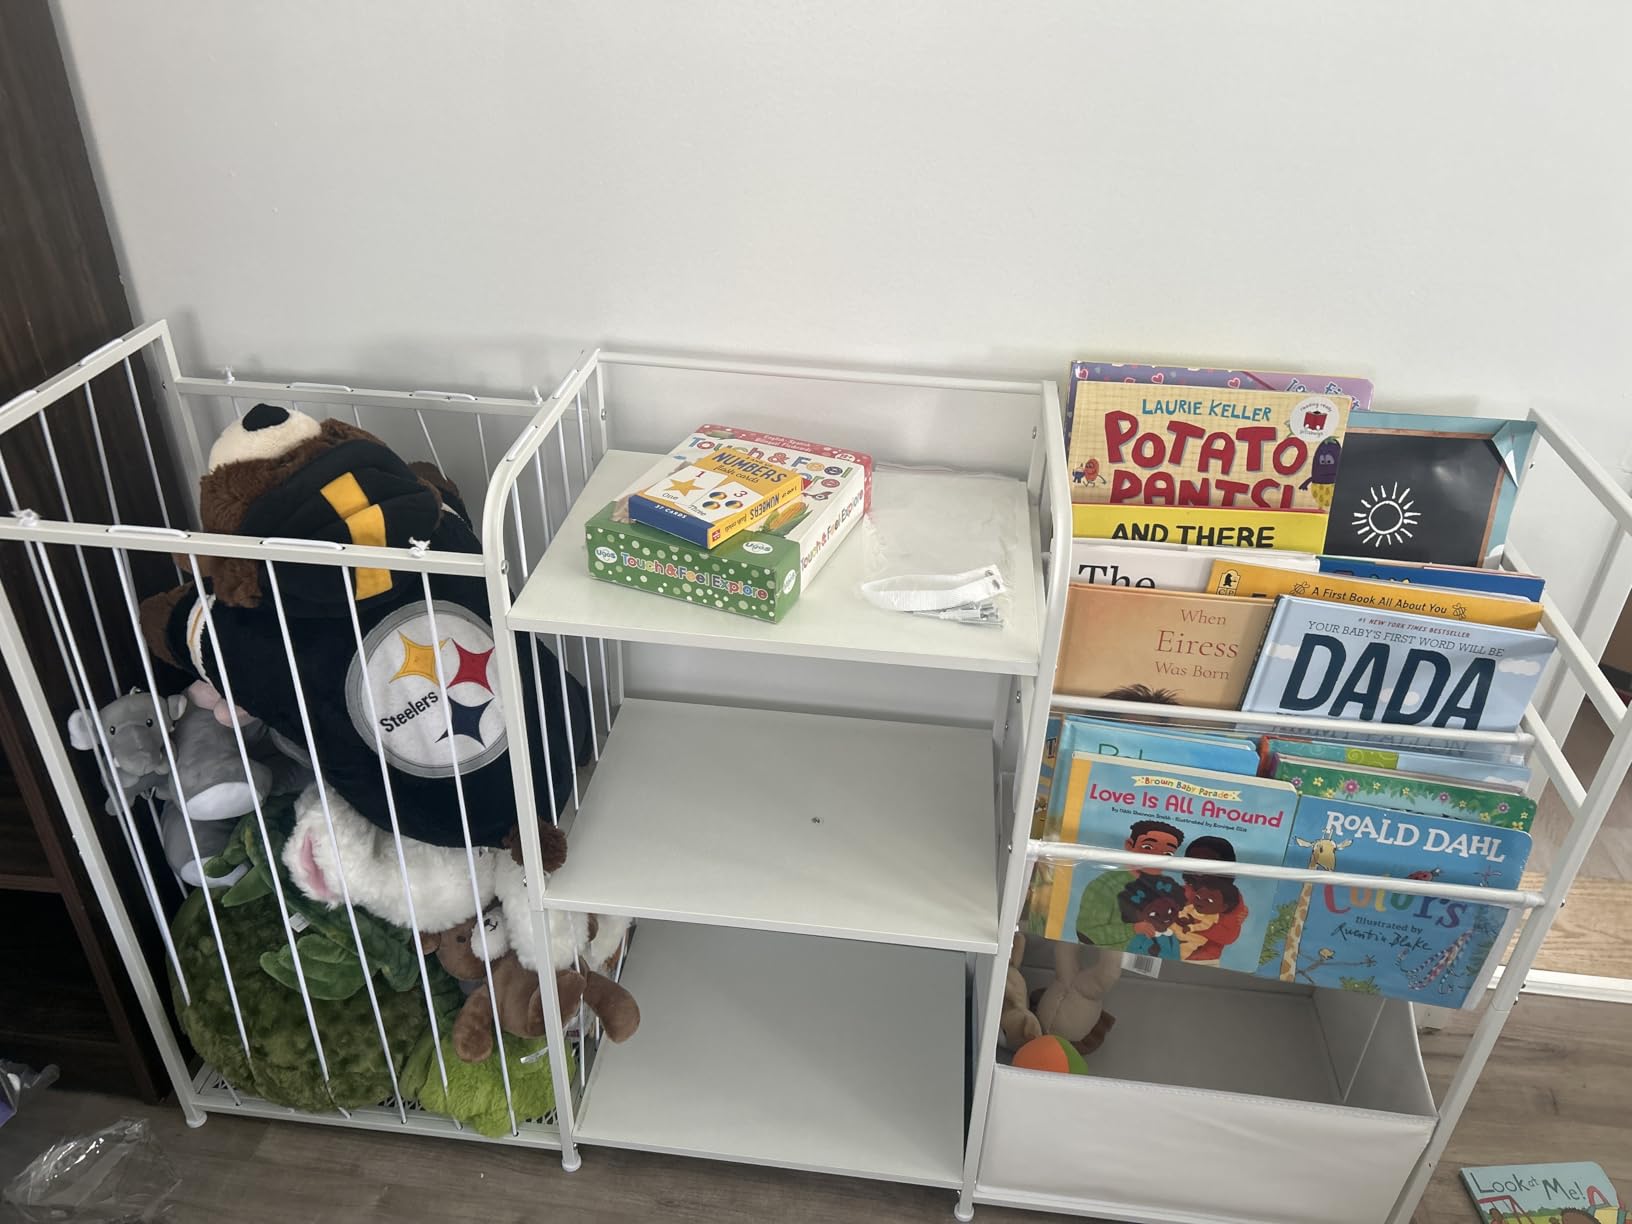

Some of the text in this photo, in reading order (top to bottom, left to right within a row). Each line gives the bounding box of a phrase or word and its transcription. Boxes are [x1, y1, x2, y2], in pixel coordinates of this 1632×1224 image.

[1141, 398, 1272, 422] LAURIE KELLER
[1104, 410, 1308, 476] POTATO
[712, 452, 787, 483] NUMBERS
[713, 464, 760, 483] flash cards
[768, 452, 790, 465] &
[791, 456, 854, 478] Feel
[661, 492, 679, 501] One
[733, 490, 748, 498] 3
[749, 493, 780, 520] NUMBERS
[664, 508, 688, 519] CARDS
[688, 504, 707, 516] Three
[1111, 523, 1275, 548] AND THERE
[621, 552, 665, 575] Touch
[665, 564, 678, 578] &
[678, 566, 709, 585] Feel
[712, 574, 769, 600] Explore
[1311, 587, 1448, 615] A First Book All About You
[1180, 609, 1227, 626] When
[1387, 621, 1405, 629] YORK
[1406, 624, 1427, 632] TIMES
[1429, 626, 1471, 638] BESTSELLER
[1157, 629, 1239, 659] Eiress
[1308, 620, 1505, 658] YOUR BABY'S FIRST WORD WILL BE
[1155, 661, 1230, 681] Was Born
[1279, 633, 1496, 731] DADA
[379, 691, 439, 733] Steelers
[1144, 777, 1229, 799] Brown Baby Parade
[1089, 783, 1284, 828] Love Is All Around
[1326, 811, 1505, 863] ROALD DAHL
[1355, 916, 1423, 935] Illustrated by
[1389, 932, 1433, 951] Blake
[1470, 1172, 1586, 1200] Look at Me!
